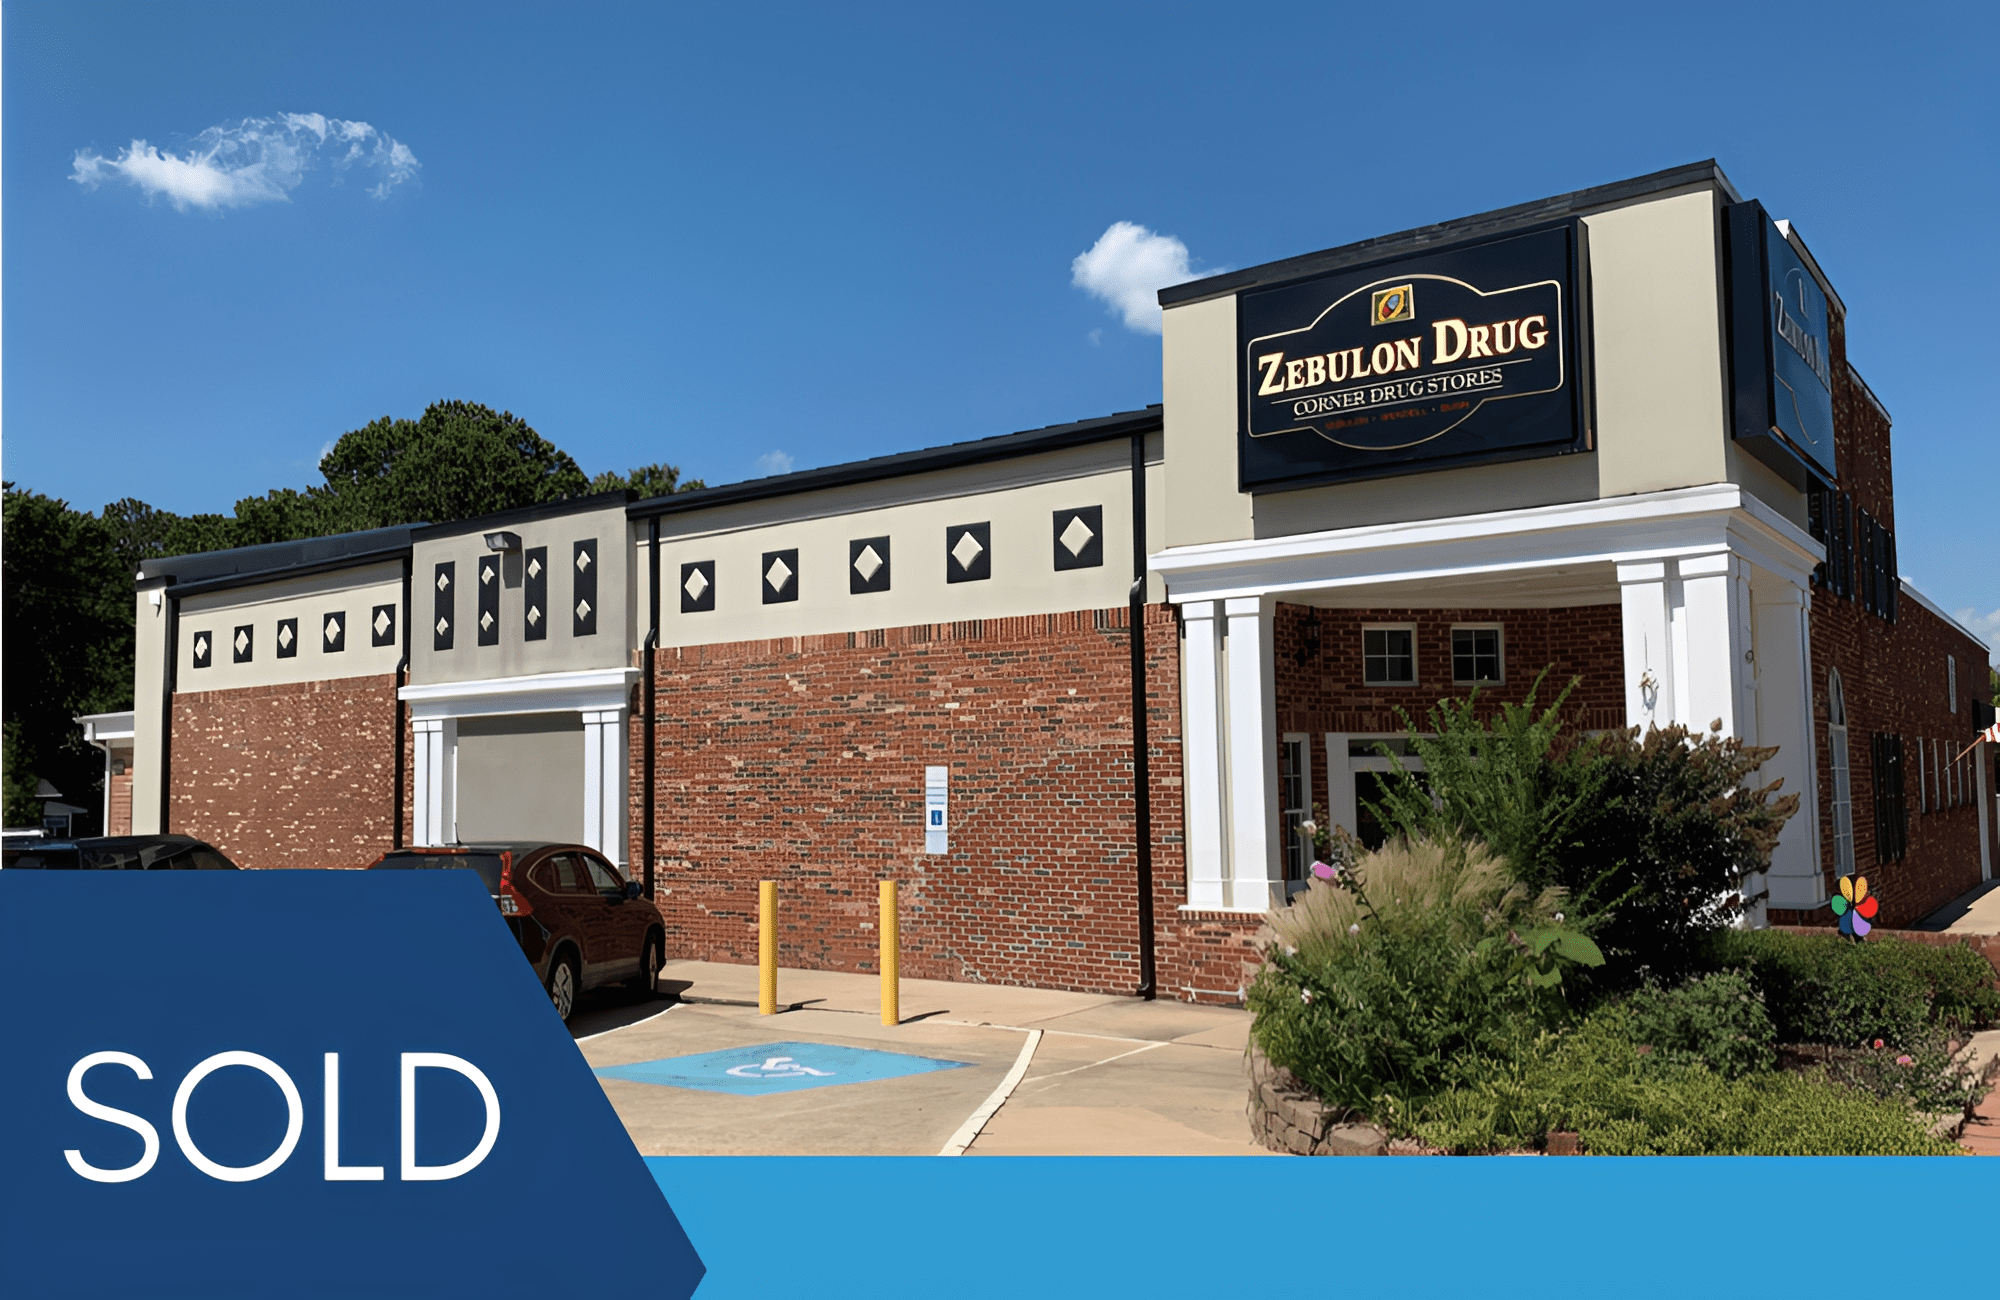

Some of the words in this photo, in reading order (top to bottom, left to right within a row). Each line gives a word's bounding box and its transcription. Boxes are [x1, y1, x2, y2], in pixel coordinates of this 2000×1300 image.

[1257, 336, 1422, 396] ZEBULON
[1431, 315, 1549, 365] DRUG
[1293, 390, 1366, 416] CORNER
[1370, 380, 1424, 403] DRUG
[1427, 368, 1503, 394] STORES
